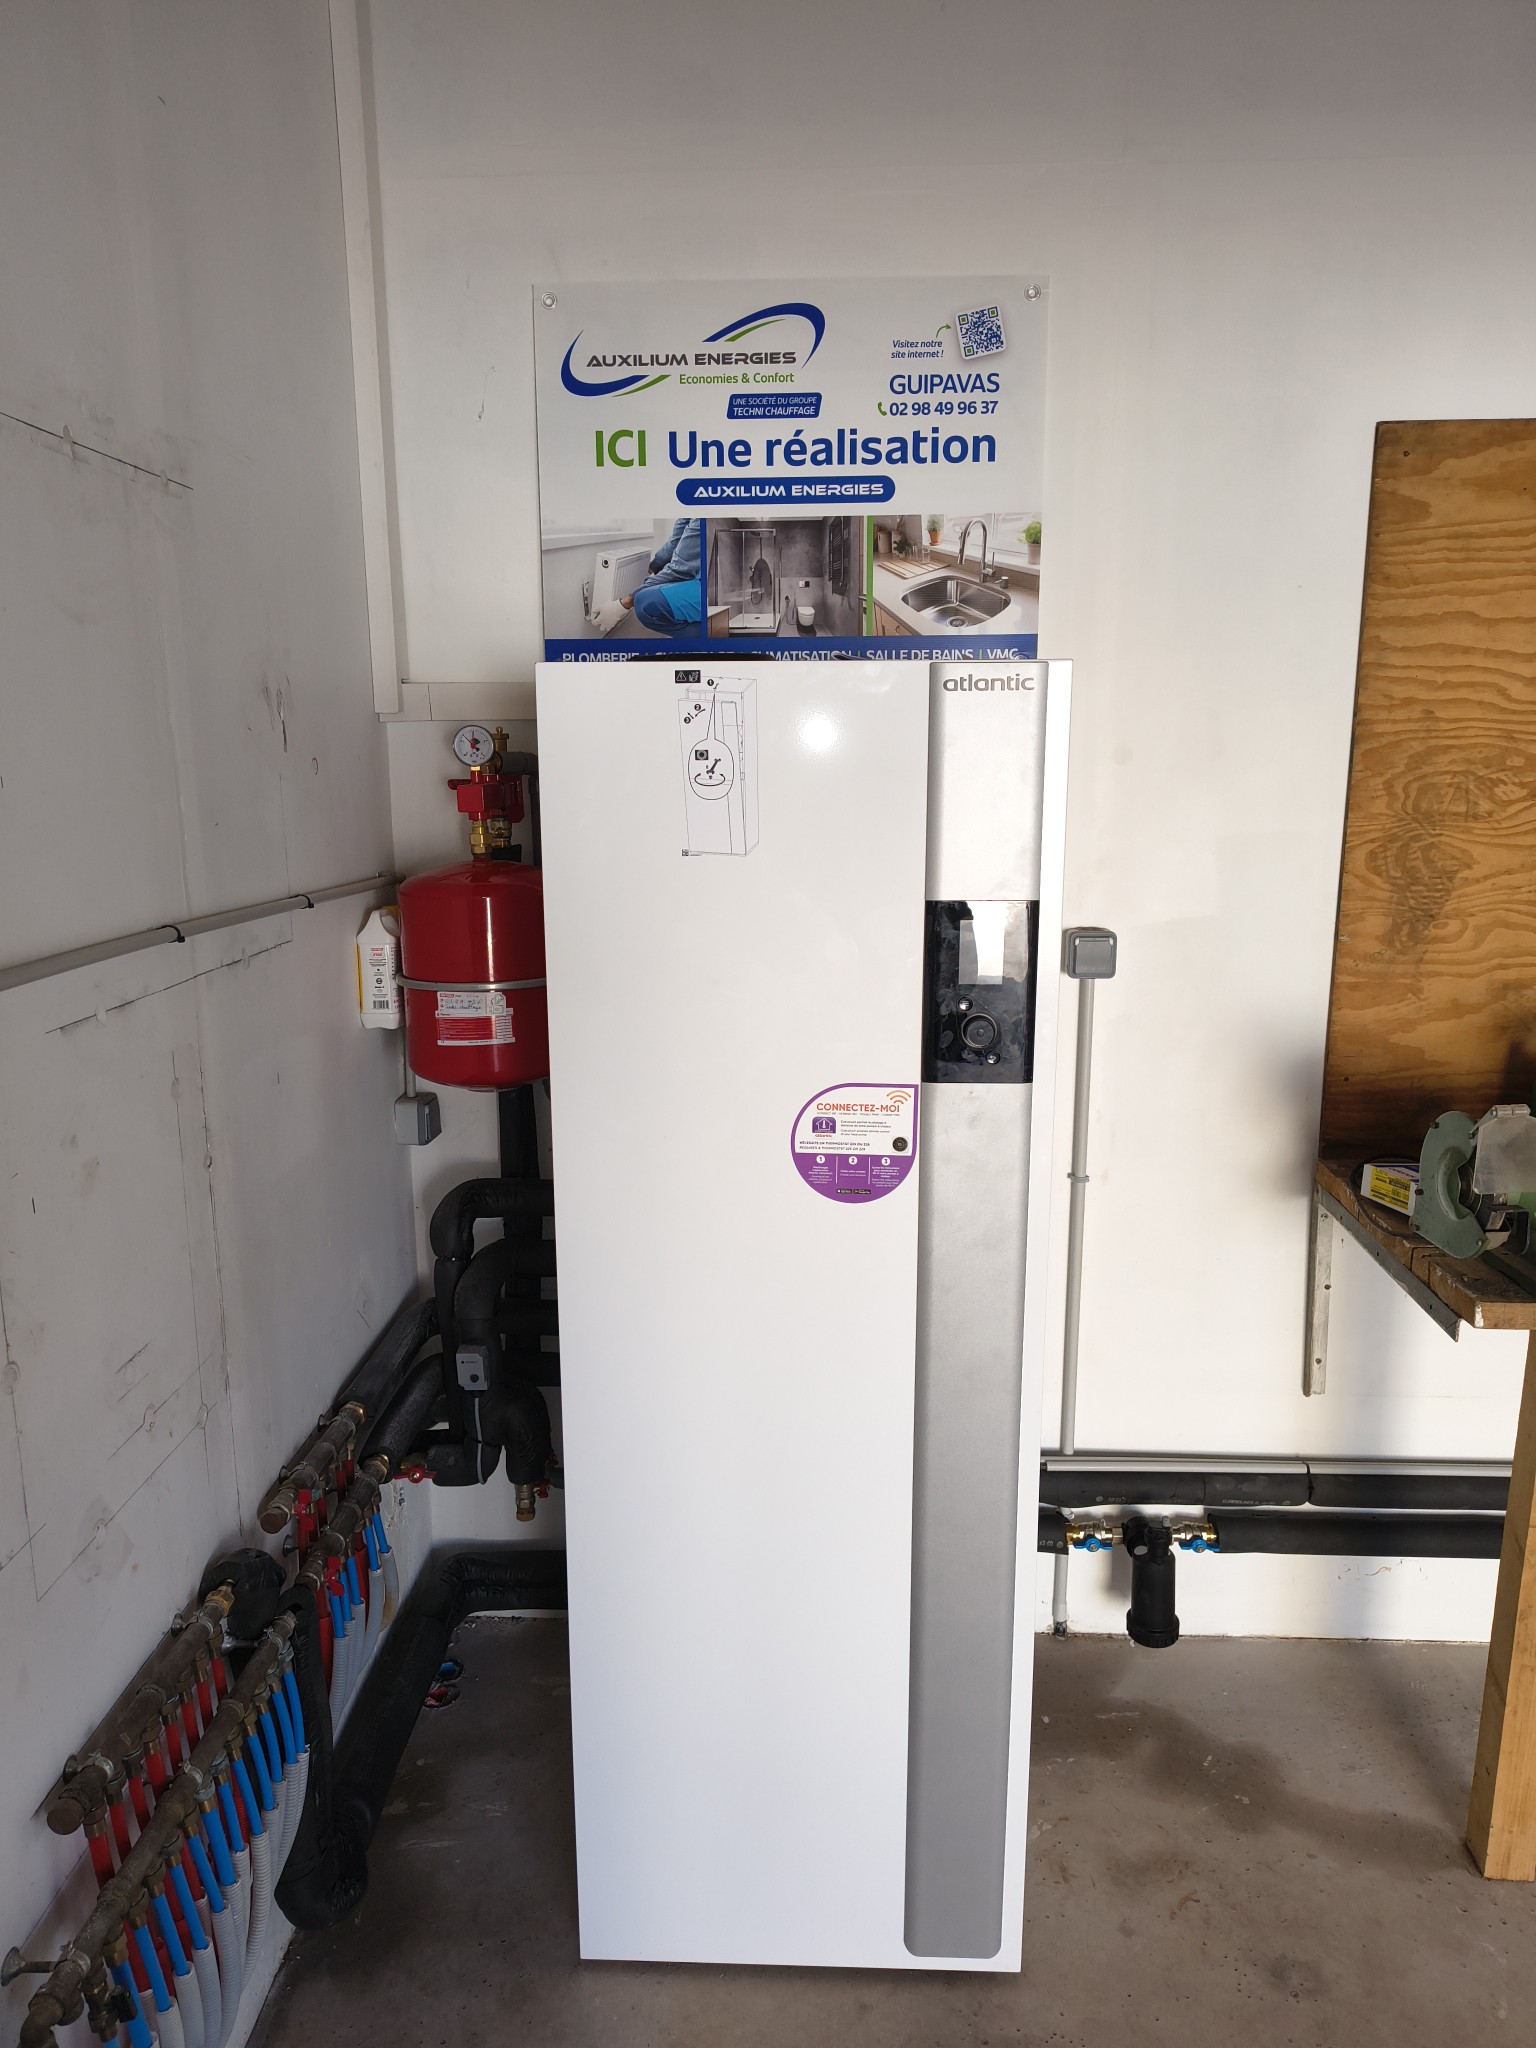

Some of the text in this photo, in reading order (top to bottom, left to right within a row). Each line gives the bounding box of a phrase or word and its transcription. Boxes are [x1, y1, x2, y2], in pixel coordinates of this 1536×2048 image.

[892, 340, 919, 348] Visitez
[586, 352, 797, 367] AUXILIUM ENERGIES
[891, 350, 906, 358] site
[907, 350, 940, 358] internet
[679, 372, 795, 384] Economies & Confort
[889, 373, 1000, 394] GUIPAVAS
[748, 396, 776, 405] SOCIÉTÉ
[789, 396, 817, 404] GROUPE
[733, 406, 816, 416] TECHNI CHAUFFAGE
[889, 400, 999, 416] 02 98 49 96 37
[595, 426, 997, 468] ICI Une réalisation
[693, 483, 884, 498] AUXILIUM ENERGIES
[562, 652, 640, 662] PLOMBERI
[911, 649, 930, 660] DE
[943, 673, 1035, 692] atlantic
[816, 1102, 900, 1113] CONNECTEZ-MOI
